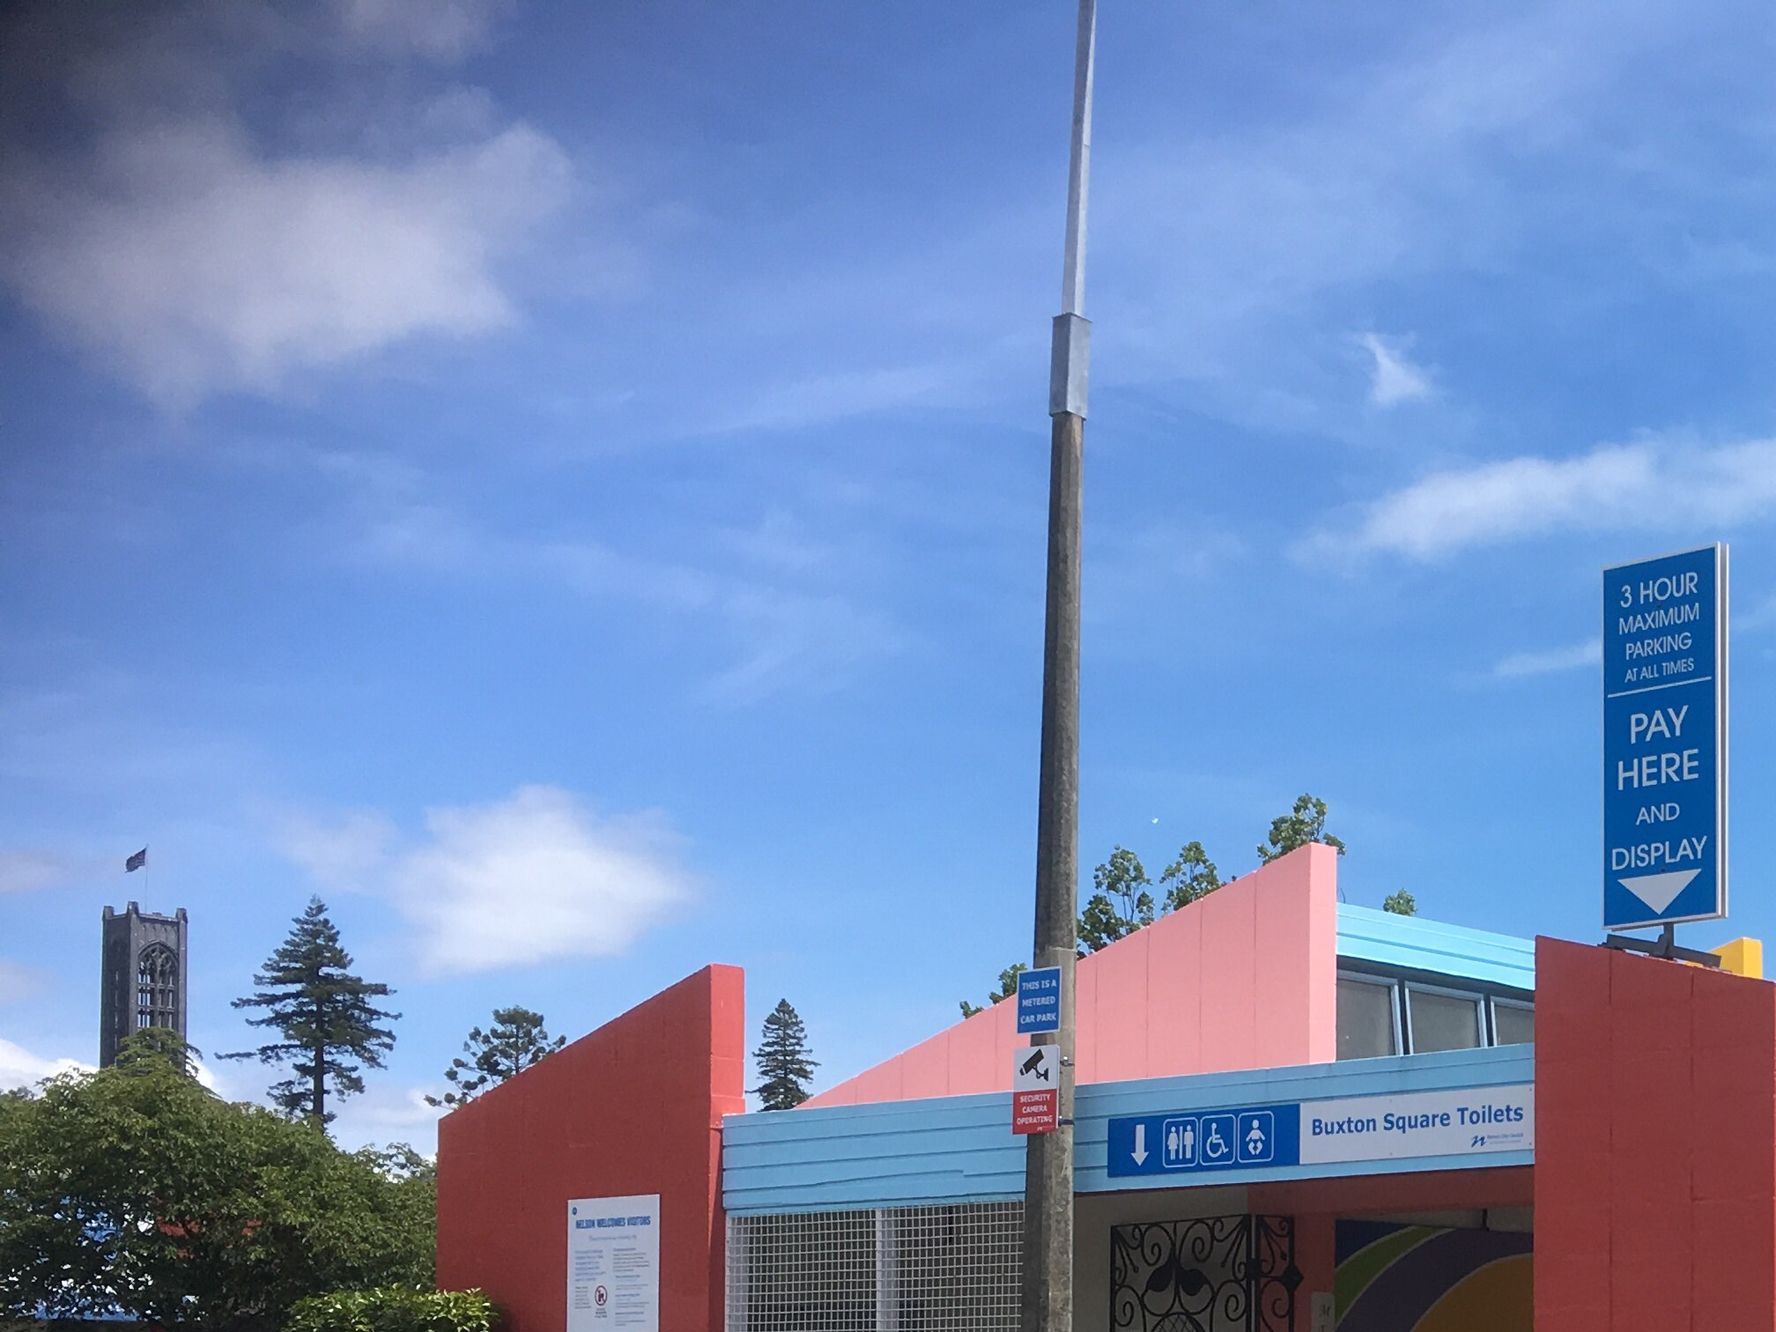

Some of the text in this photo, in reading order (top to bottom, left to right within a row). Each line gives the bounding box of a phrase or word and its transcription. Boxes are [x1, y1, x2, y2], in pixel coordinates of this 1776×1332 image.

[1620, 572, 1698, 608] 3 HOUR
[1619, 602, 1699, 635] MAXIMUM
[1625, 632, 1692, 660] PARKING
[1624, 658, 1694, 683] AT ALL TIMES
[1630, 705, 1688, 744] PAY
[1617, 749, 1699, 791] HERE
[1635, 803, 1680, 826] AND
[1611, 835, 1707, 871] DISPLAY
[1022, 979, 1057, 990] THIS IS A
[1022, 996, 1056, 1007] METERED
[1020, 1012, 1057, 1024] CAR PARK
[1020, 1094, 1050, 1103] SECURITY
[1022, 1105, 1048, 1114] CAMERA
[1016, 1115, 1053, 1125] OPERATING
[1311, 1104, 1524, 1136] Buxton Square Toilets
